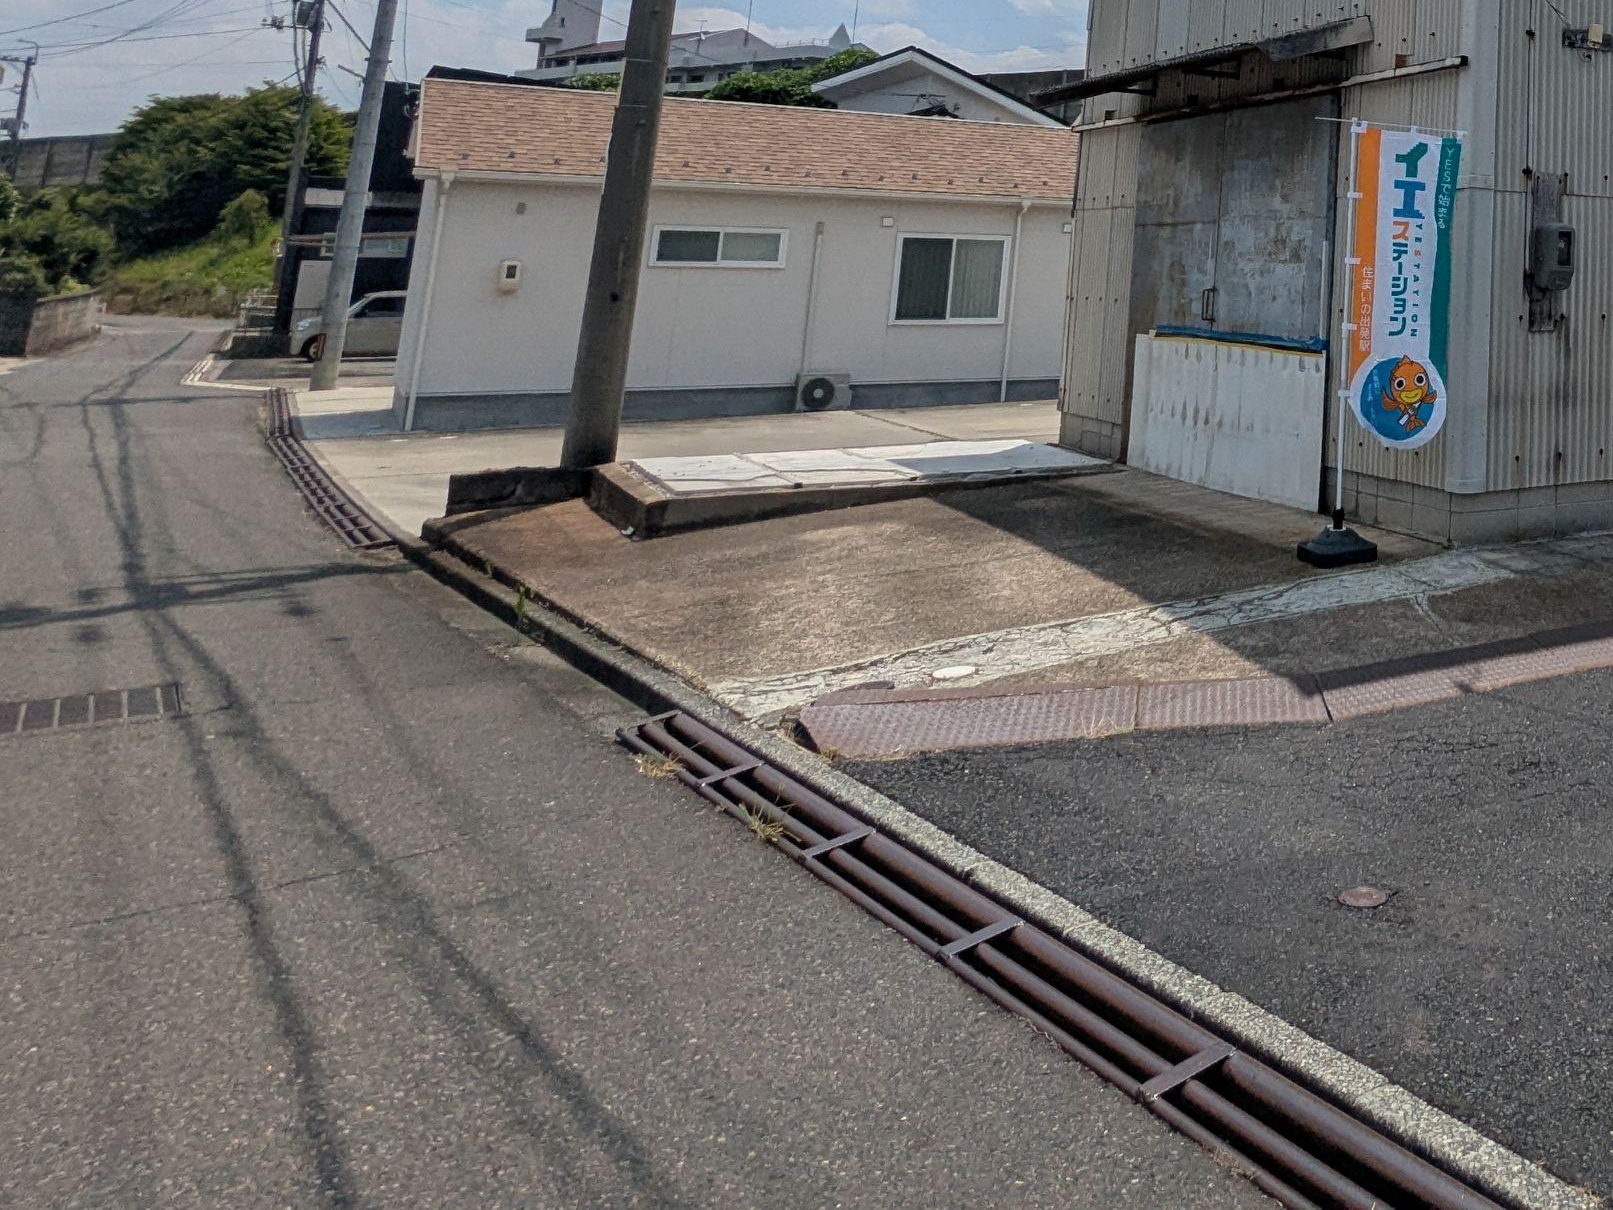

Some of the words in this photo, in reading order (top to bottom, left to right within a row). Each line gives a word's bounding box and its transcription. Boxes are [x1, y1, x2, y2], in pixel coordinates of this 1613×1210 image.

[1437, 147, 1455, 229] YESで始まる
[1389, 142, 1428, 337] イエステーション
[1358, 265, 1374, 352] 住まいの出発駅
